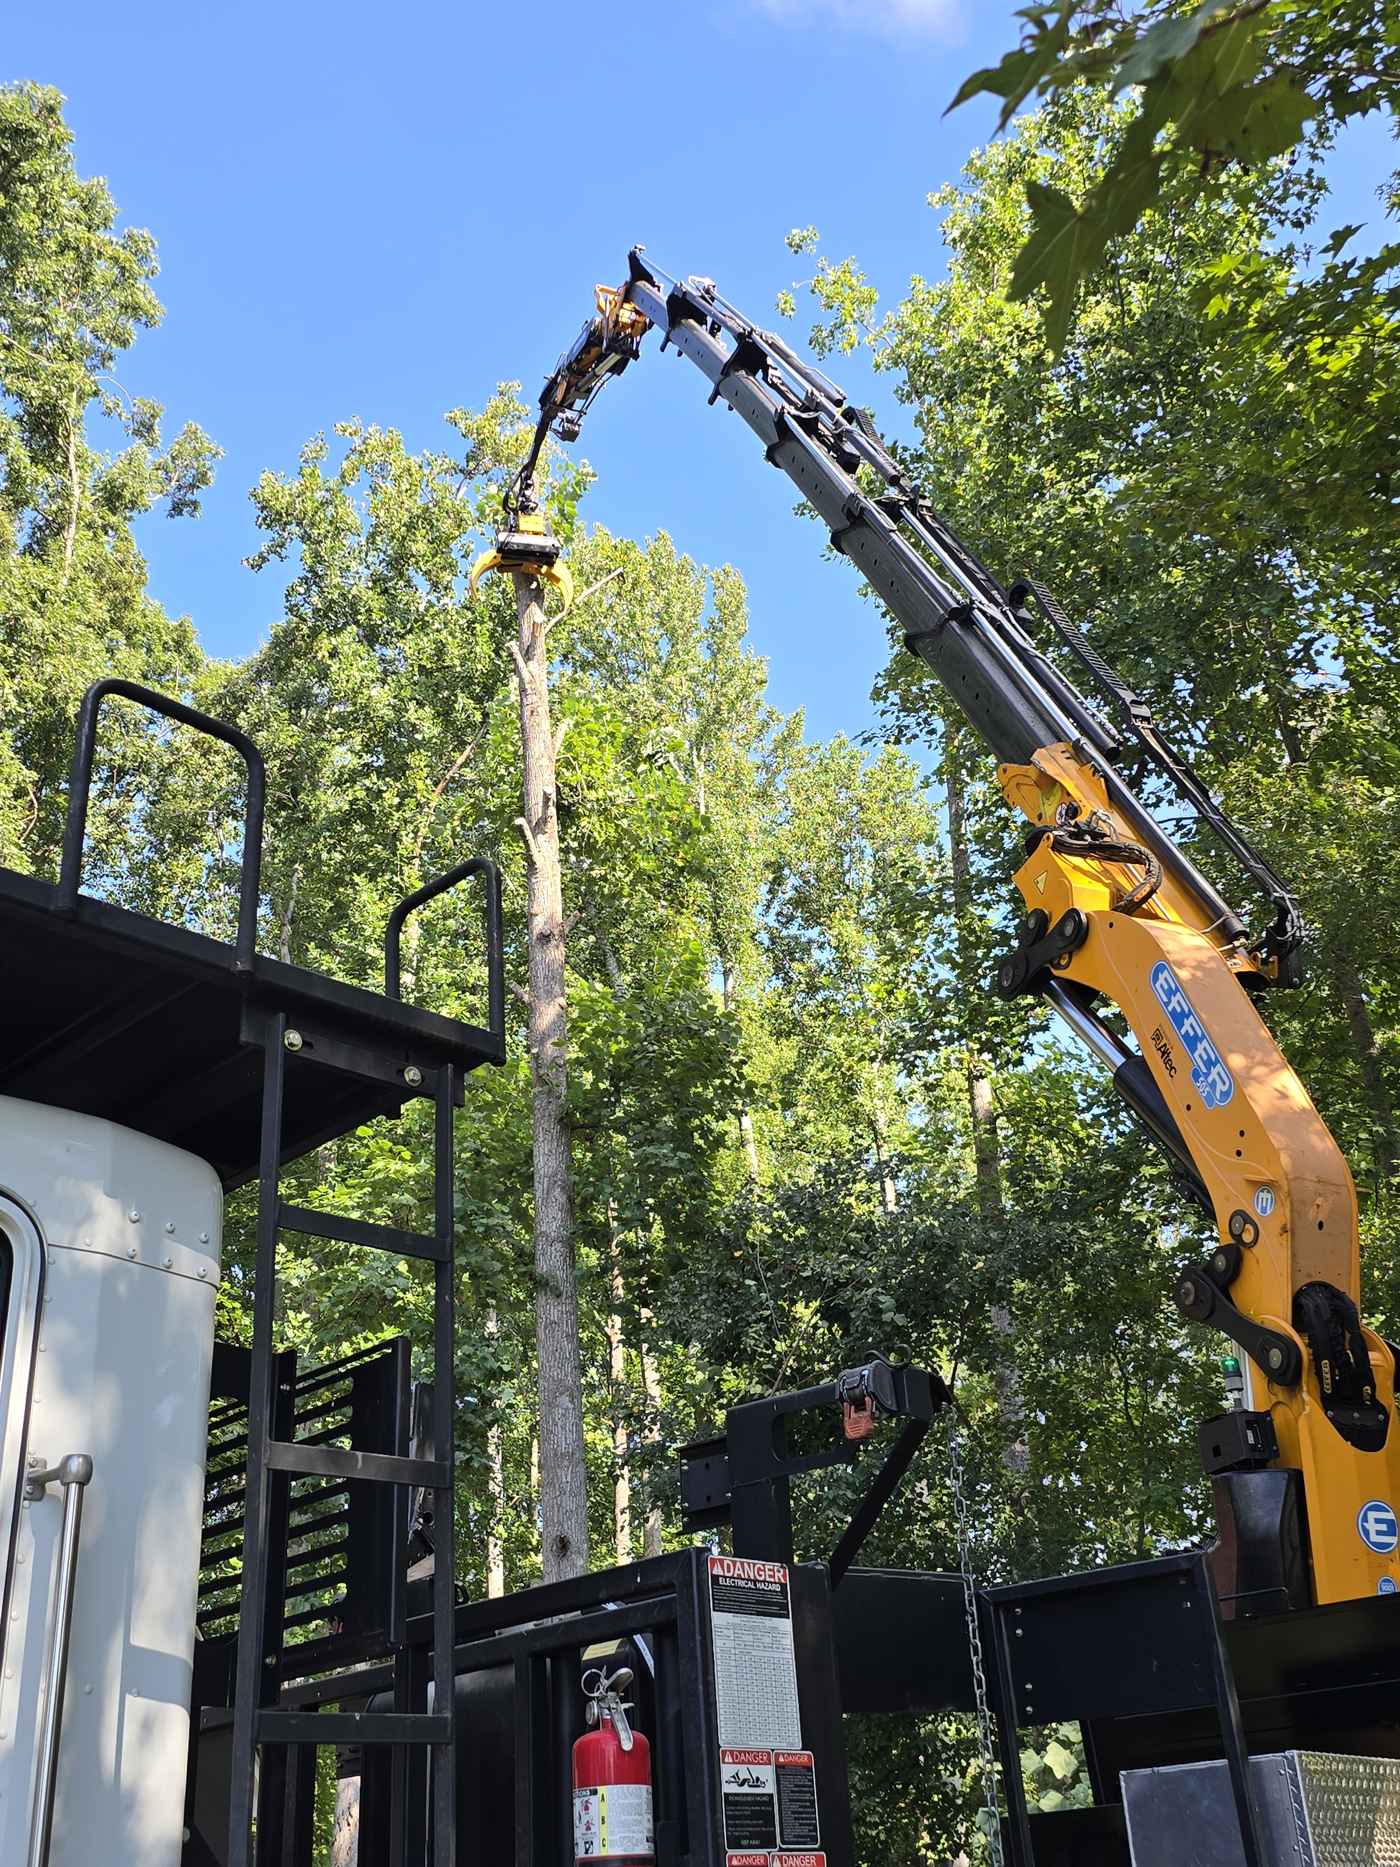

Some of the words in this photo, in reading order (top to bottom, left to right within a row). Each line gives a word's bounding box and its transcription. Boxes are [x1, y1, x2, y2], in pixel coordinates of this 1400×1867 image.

[1154, 967, 1231, 1100] EFFER
[1156, 1042, 1177, 1078] Altec
[1362, 1510, 1398, 1544] E
[723, 1559, 787, 1584] DANGER
[719, 1577, 756, 1589] ELECTRICAL
[756, 1581, 781, 1592] HAZARD
[733, 1751, 769, 1764] DANGER
[783, 1753, 809, 1763] DANGER
[736, 1855, 766, 1866] DANGER
[782, 1856, 817, 1867] DANGER
